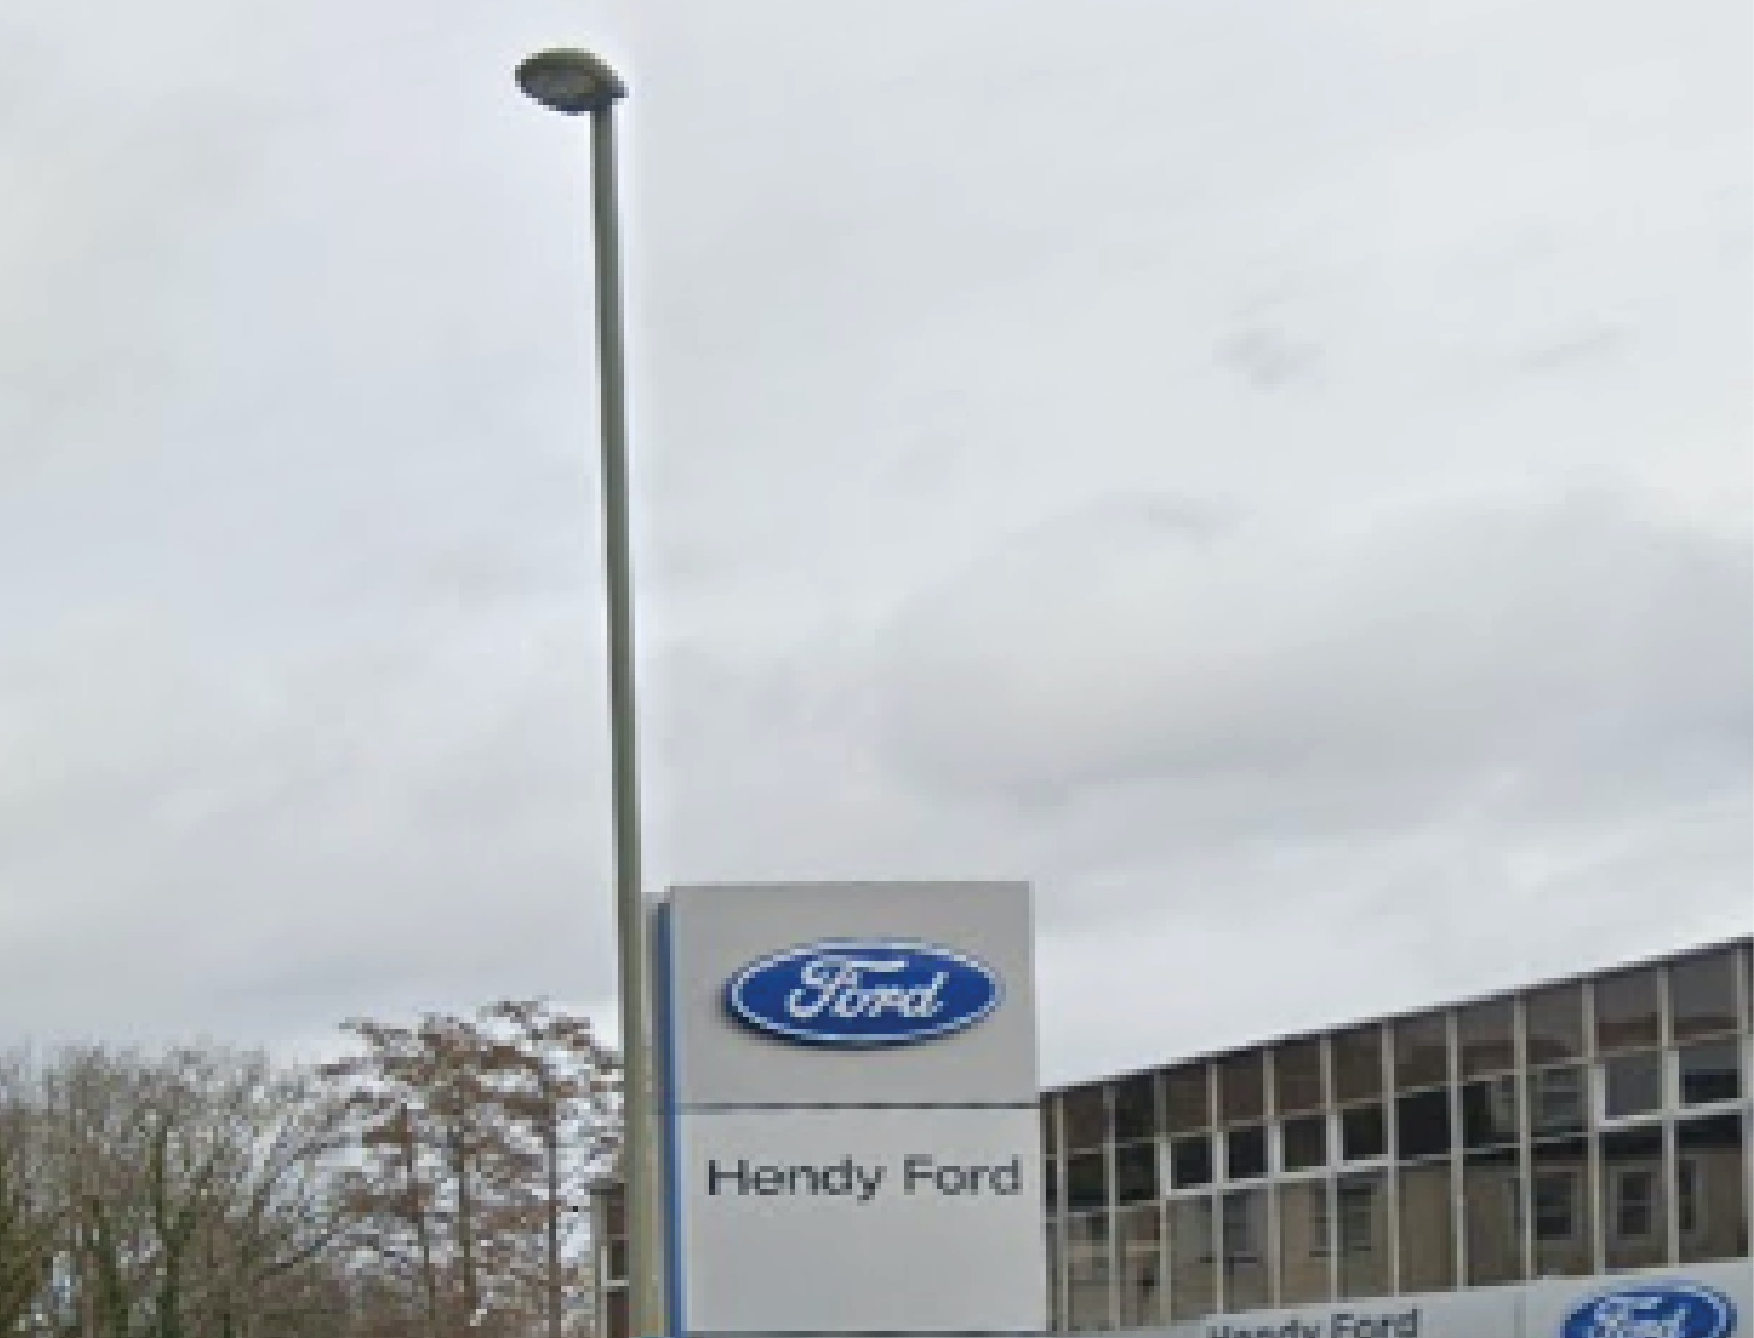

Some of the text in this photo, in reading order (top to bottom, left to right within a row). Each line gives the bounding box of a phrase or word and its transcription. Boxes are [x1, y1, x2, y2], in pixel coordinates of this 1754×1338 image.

[786, 953, 946, 1027] Ford
[707, 1156, 1021, 1203] Hendy Ford
